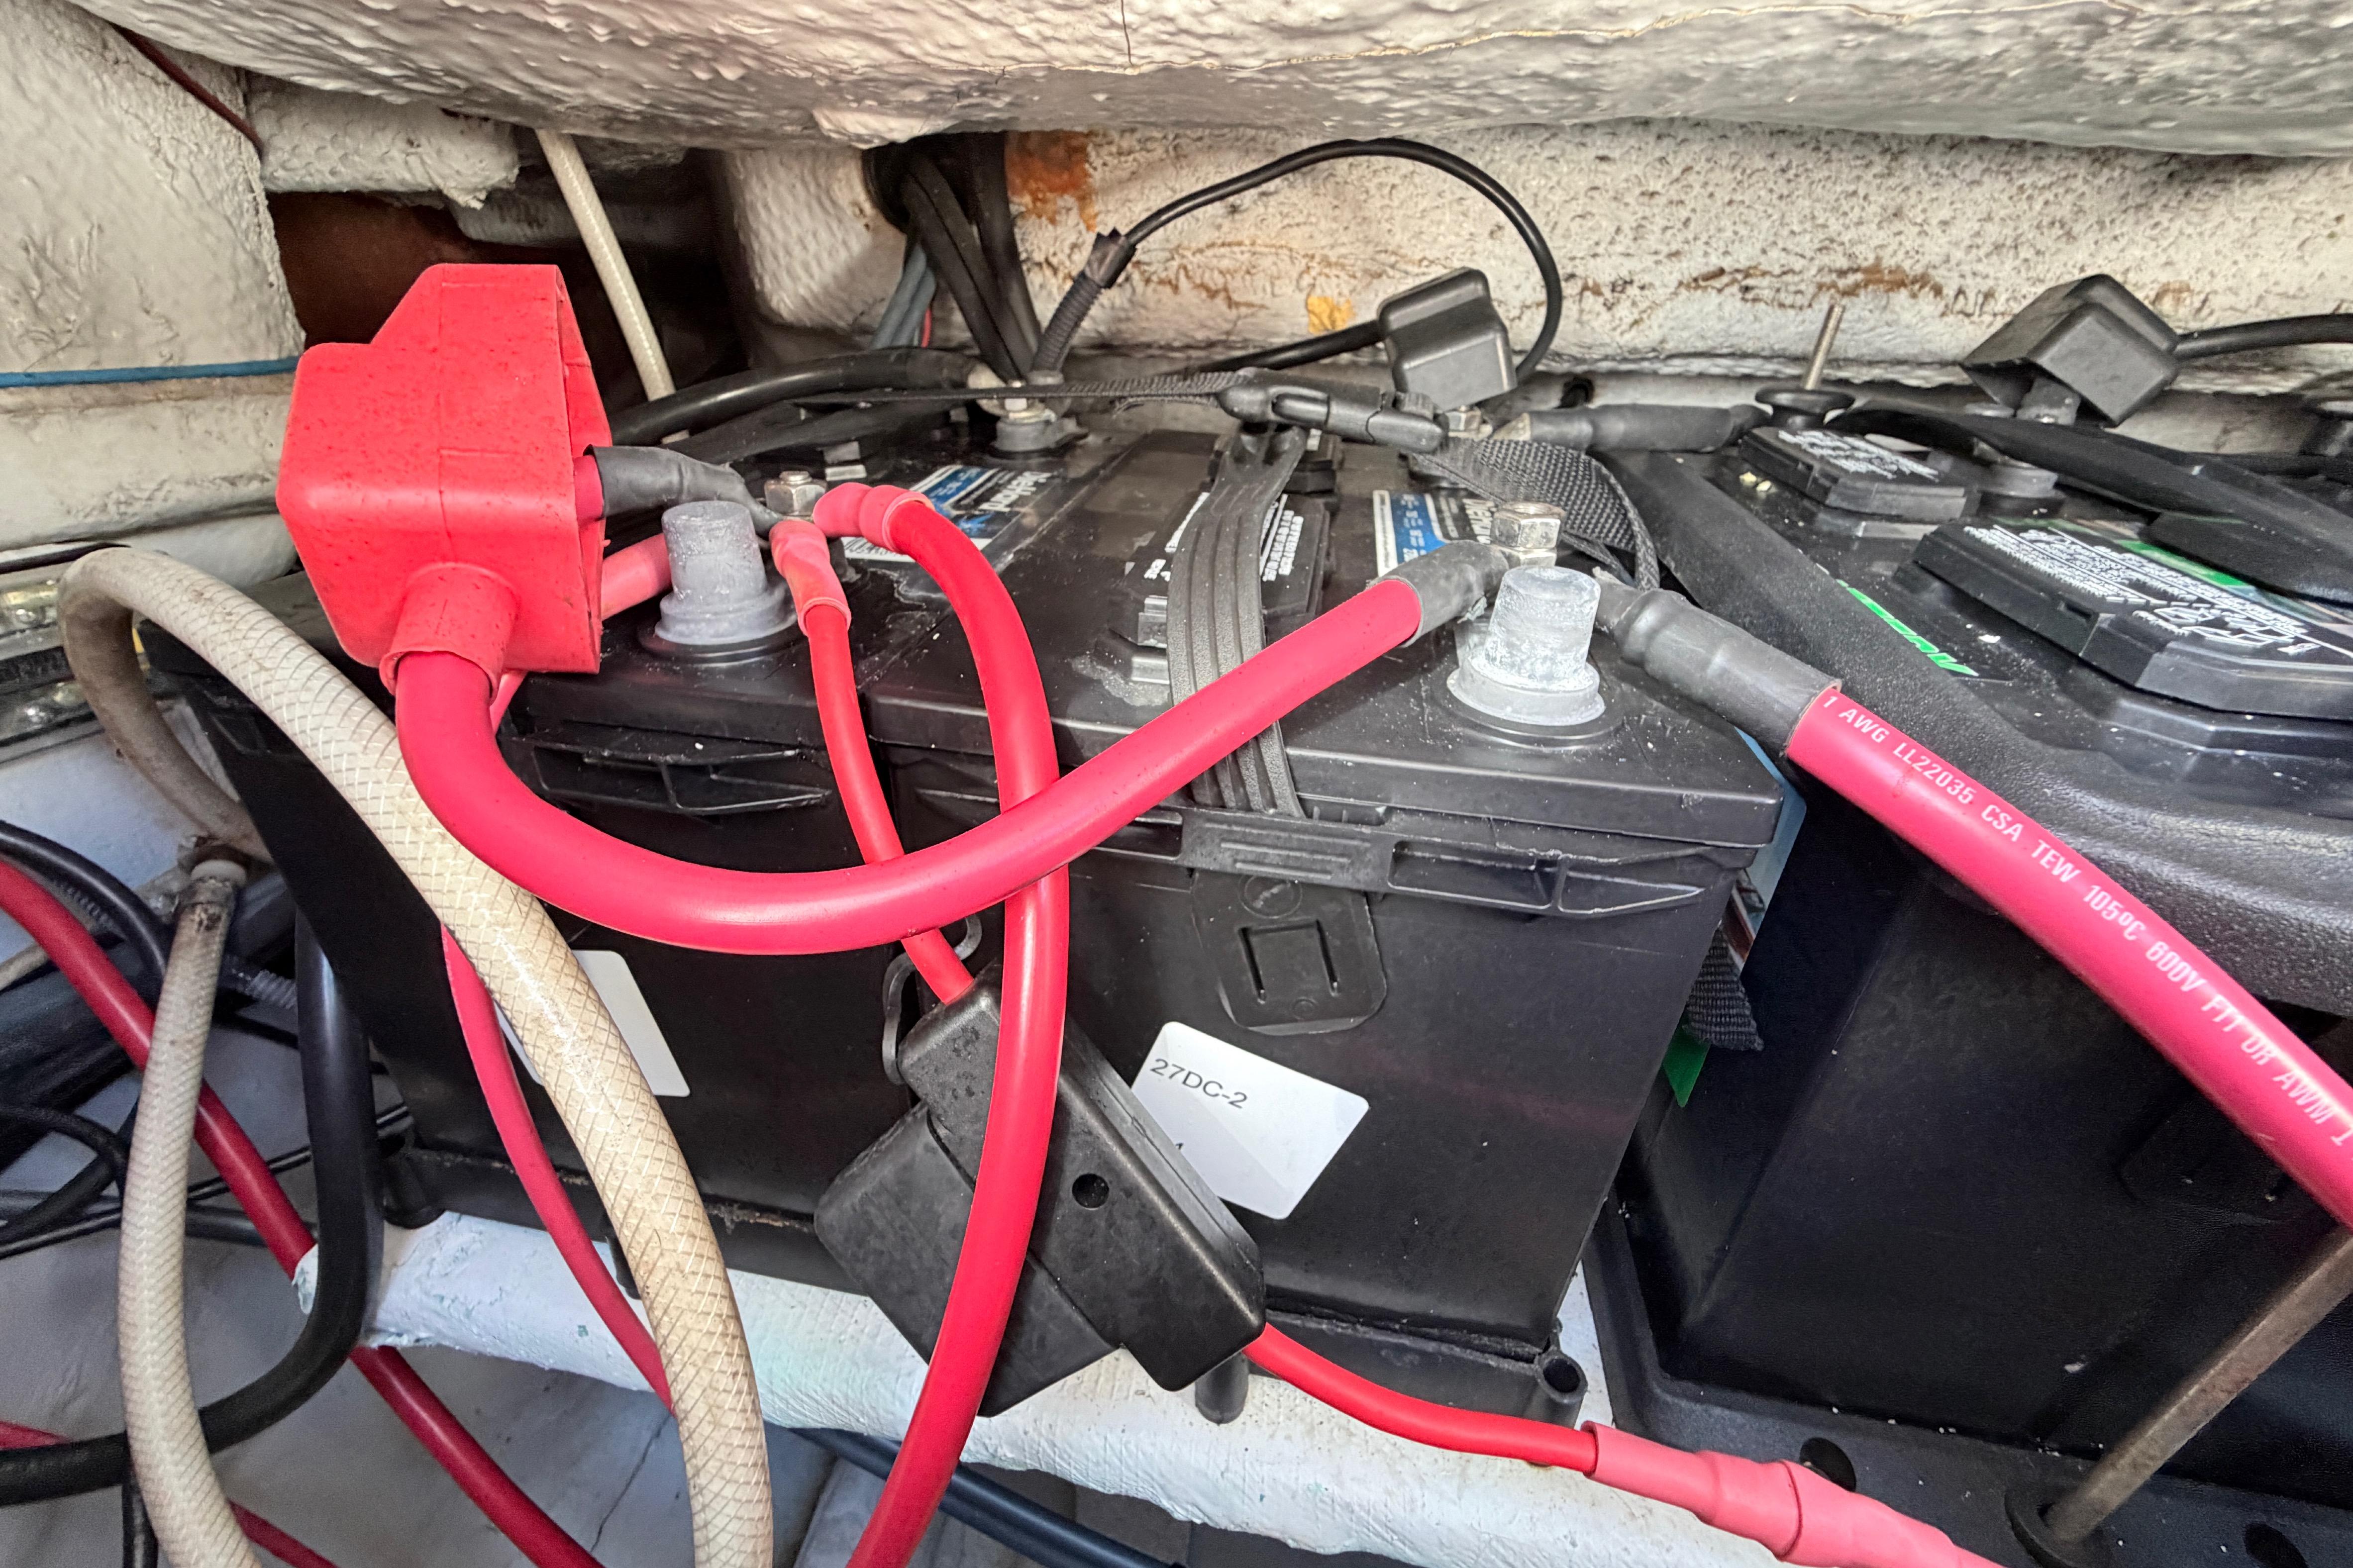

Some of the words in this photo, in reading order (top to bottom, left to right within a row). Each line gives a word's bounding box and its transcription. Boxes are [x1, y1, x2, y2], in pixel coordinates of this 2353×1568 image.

[1823, 695, 1838, 708] 1
[1839, 708, 1890, 743] AWG
[1892, 742, 1977, 804] LL22035
[1981, 804, 2024, 842] CSA
[2031, 839, 2082, 882] TEW
[2146, 941, 2207, 992] 600V
[2241, 1035, 2277, 1066] OR
[2272, 1070, 2335, 1125] AWM
[1149, 1058, 1249, 1109] 27DC-2
